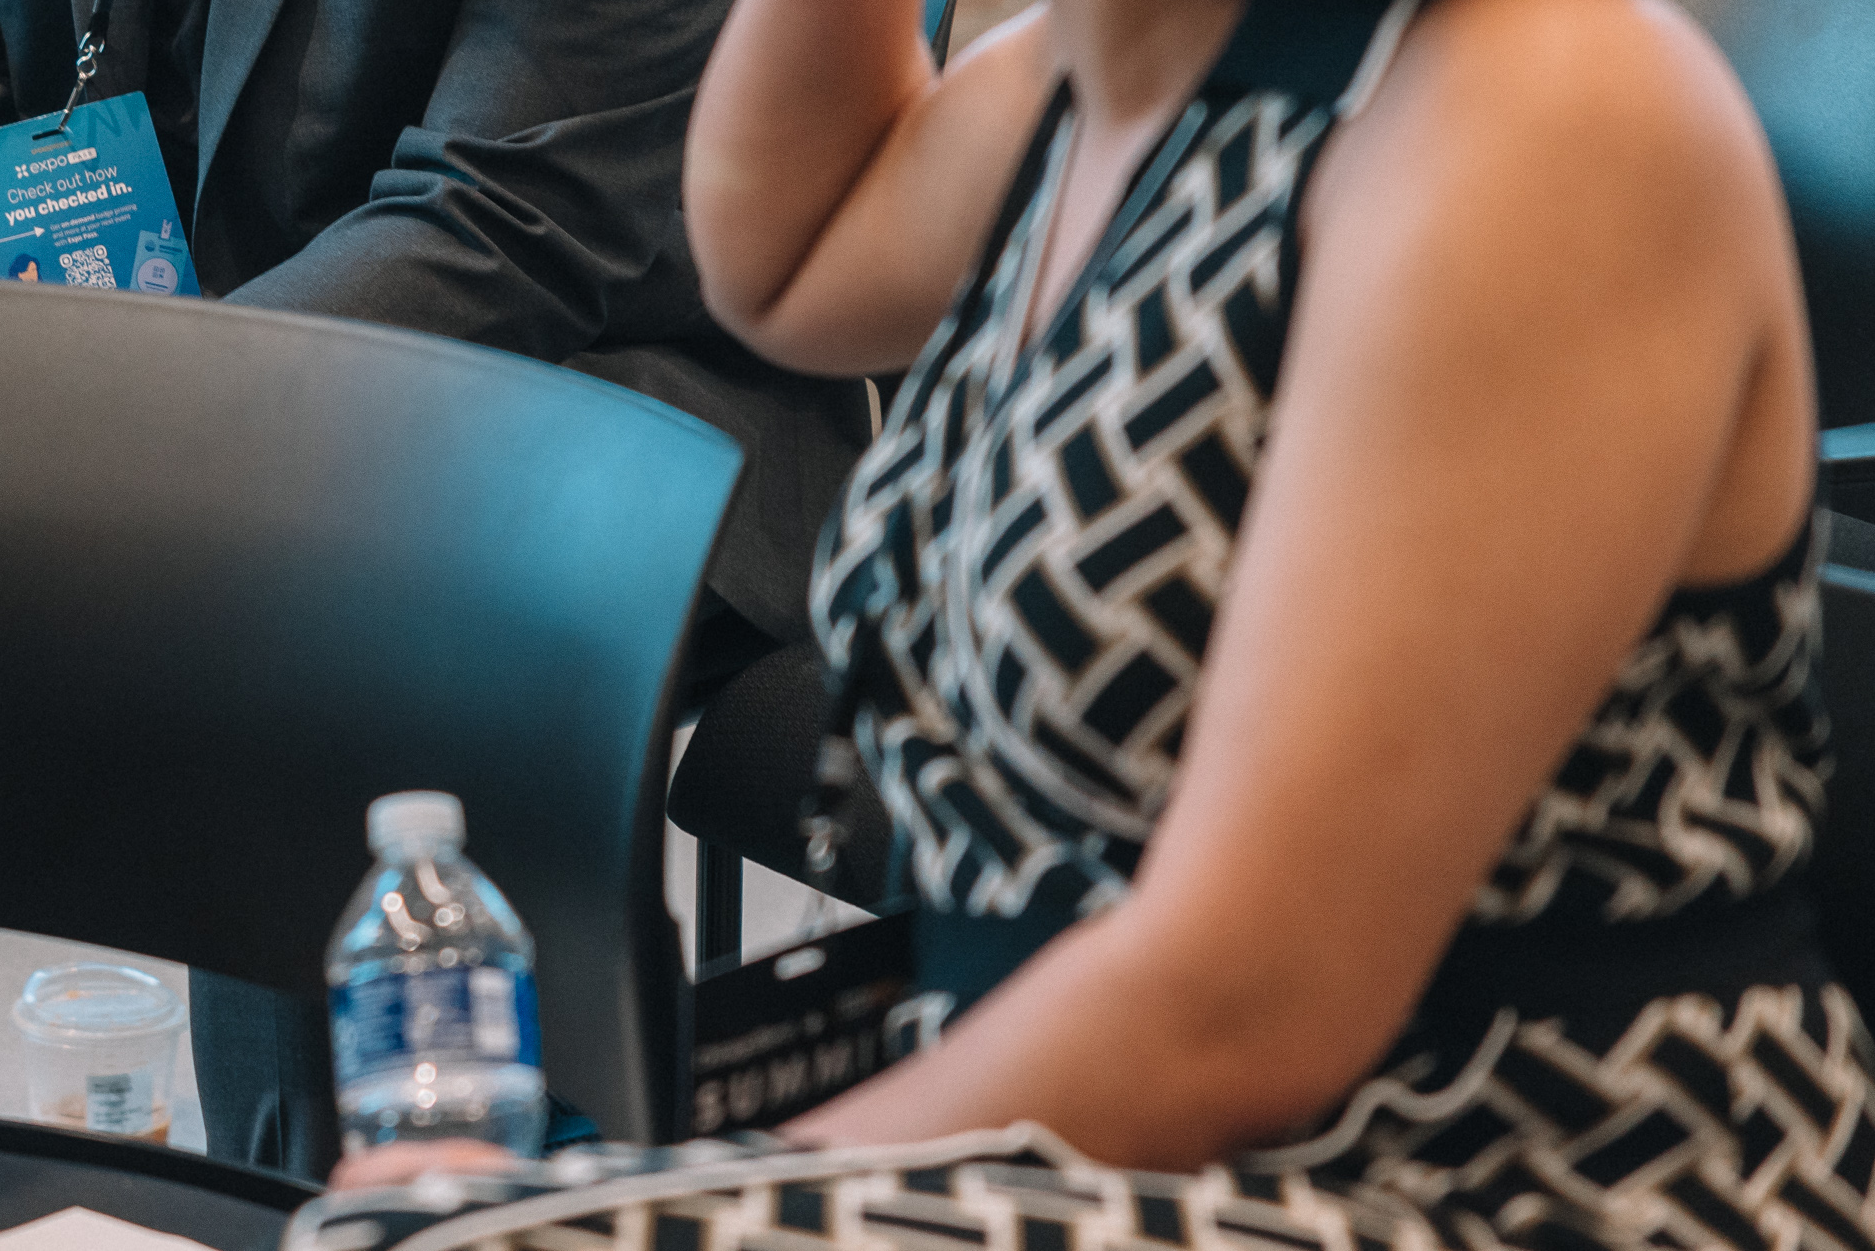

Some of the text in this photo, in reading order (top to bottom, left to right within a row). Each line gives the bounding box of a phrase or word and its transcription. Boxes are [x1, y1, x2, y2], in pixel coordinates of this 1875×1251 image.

[29, 155, 68, 174] expo
[5, 181, 133, 226] you checked in.
[7, 165, 117, 204] Check out how
